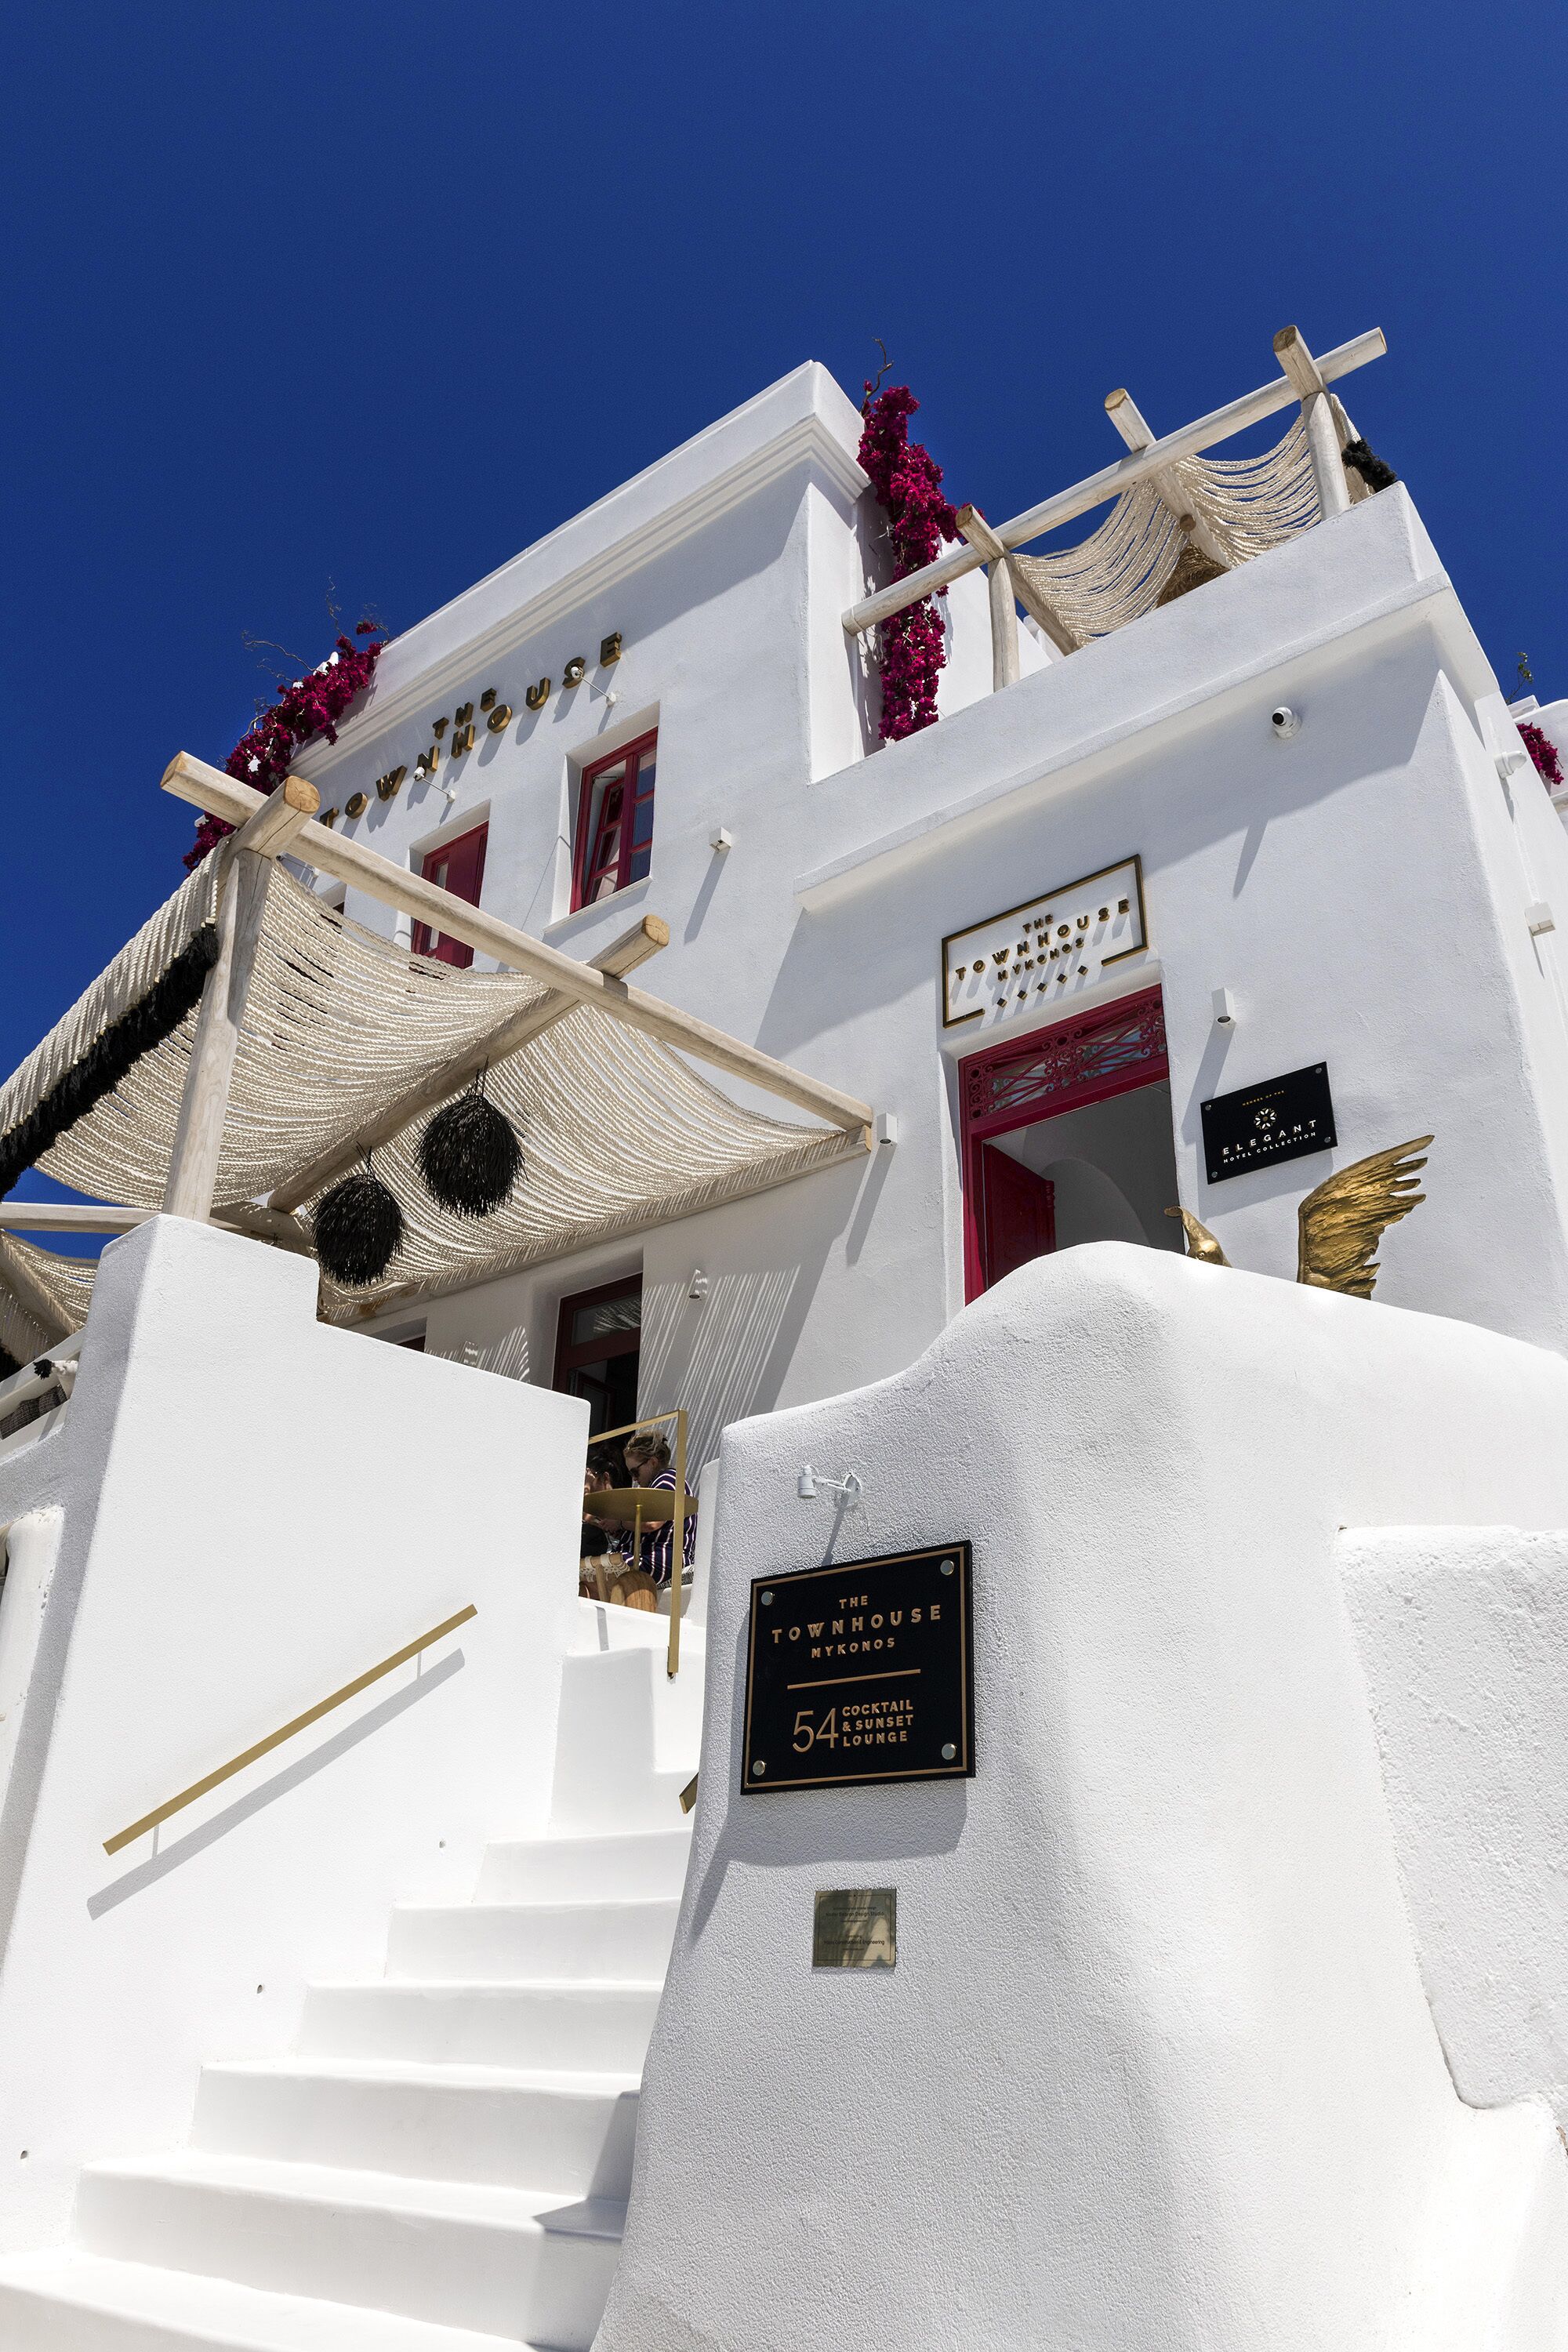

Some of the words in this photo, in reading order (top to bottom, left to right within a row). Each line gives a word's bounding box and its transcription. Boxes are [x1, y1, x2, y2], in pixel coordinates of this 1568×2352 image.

[319, 631, 622, 829] TOWNHOUSE
[431, 688, 497, 739] THE
[955, 898, 1130, 981] TOWNHOUSE
[1022, 913, 1054, 934] THE
[997, 938, 1084, 982] MYKONOS
[1222, 1120, 1316, 1156] ELEGANT
[1223, 1152, 1252, 1163] HOTEL
[1256, 1131, 1316, 1153] COLLECTION
[839, 1595, 869, 1609] THE
[772, 1605, 942, 1643] TOWNHOUSE
[811, 1637, 895, 1658] MYKONOS
[842, 1699, 914, 1717] COCKTAIL
[842, 1721, 851, 1732] &
[855, 1715, 914, 1731] SUNSET
[793, 1708, 839, 1752] 54
[843, 1730, 908, 1748] LOUNGE
